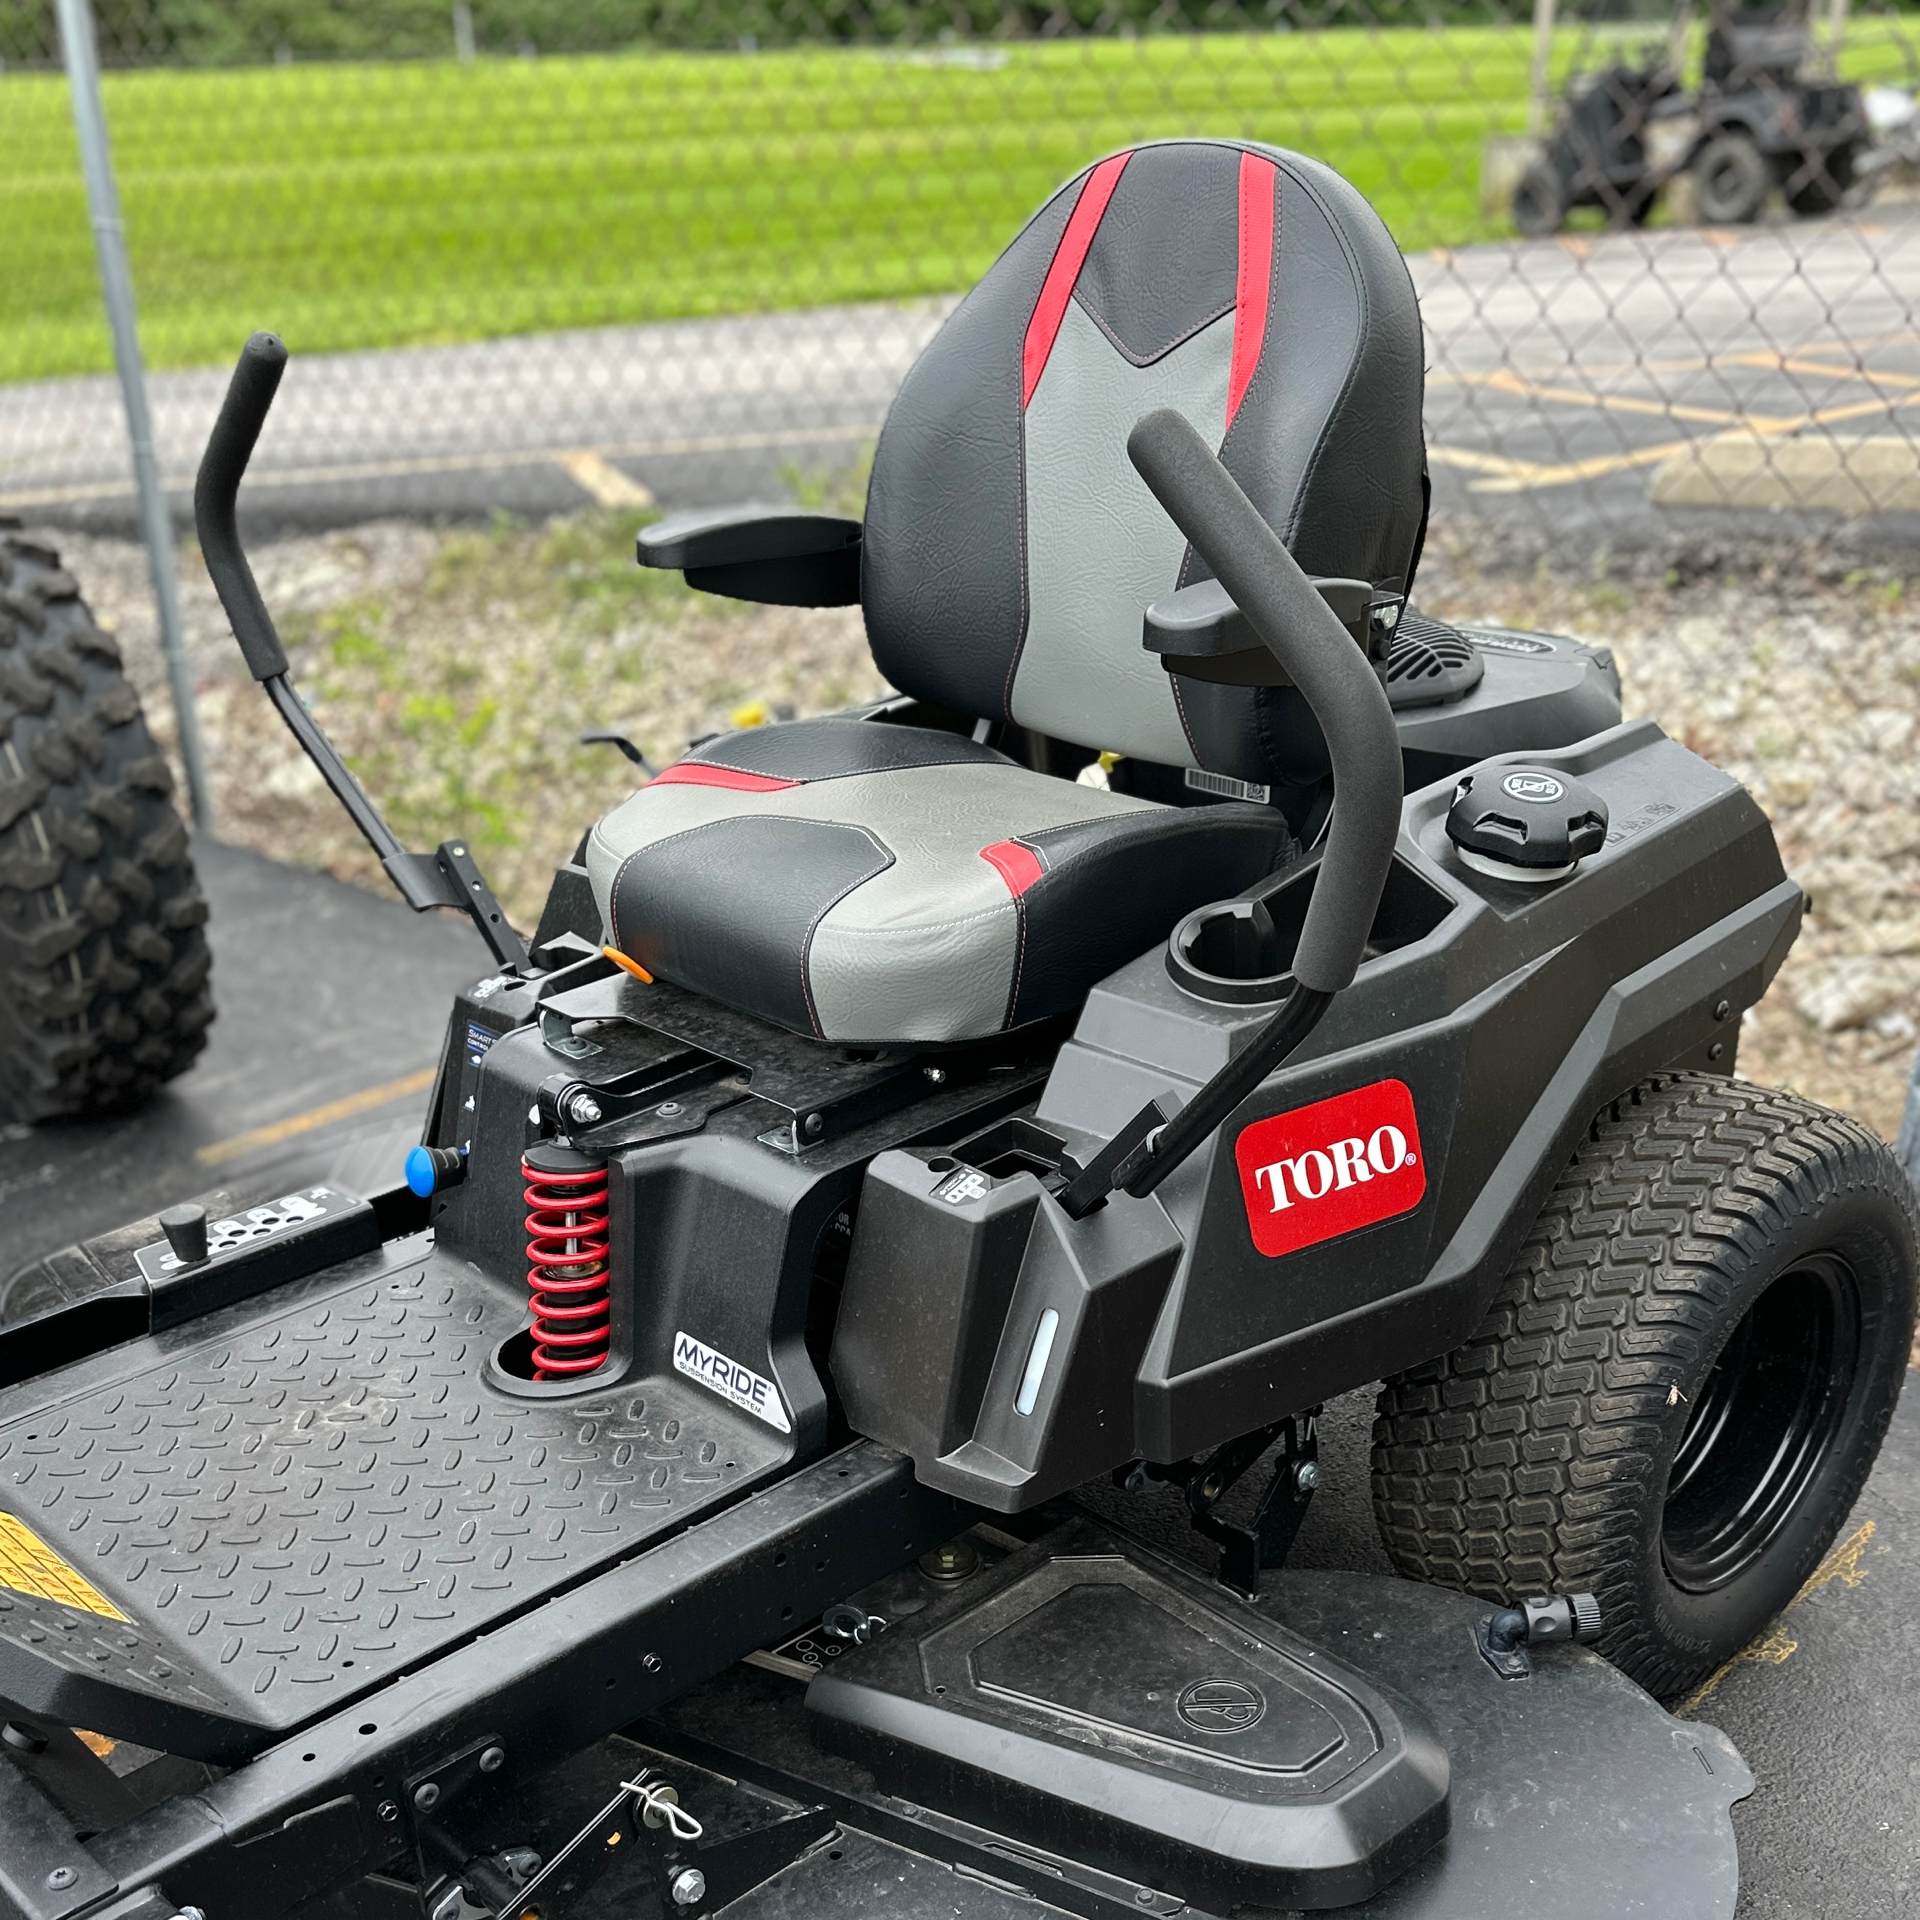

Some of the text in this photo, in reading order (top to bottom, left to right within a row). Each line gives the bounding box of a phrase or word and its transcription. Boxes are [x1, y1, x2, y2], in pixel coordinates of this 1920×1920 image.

[468, 1029, 492, 1046] SMART
[679, 1361, 762, 1414] SUSPENSION SYSTEM
